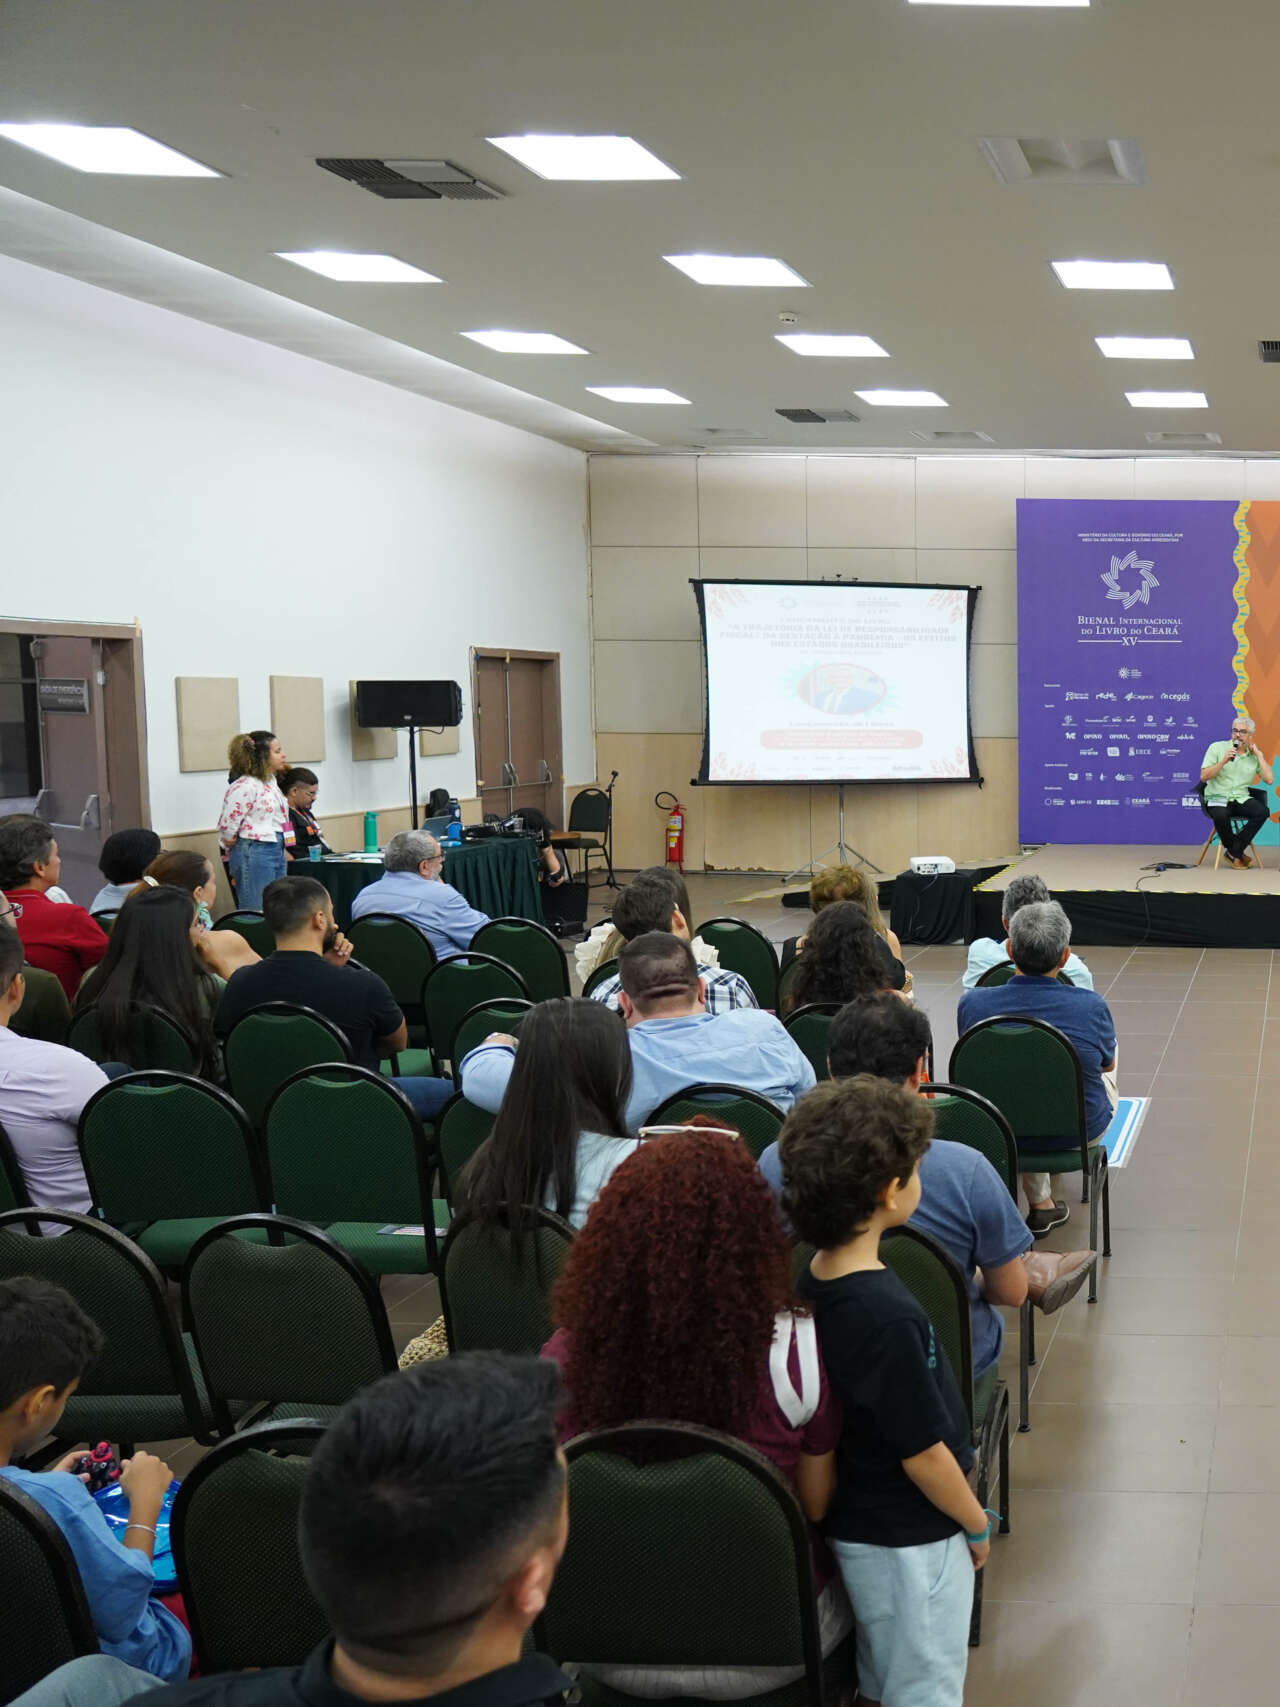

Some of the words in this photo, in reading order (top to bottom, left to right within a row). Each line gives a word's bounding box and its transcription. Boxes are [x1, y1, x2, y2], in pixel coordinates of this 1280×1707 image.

[1077, 615, 1116, 625] BIENAL
[1119, 617, 1183, 625] INTERNACIONAL
[1096, 626, 1127, 635] LIVRO
[1144, 625, 1179, 635] CEARÁ
[1121, 636, 1138, 646] XV
